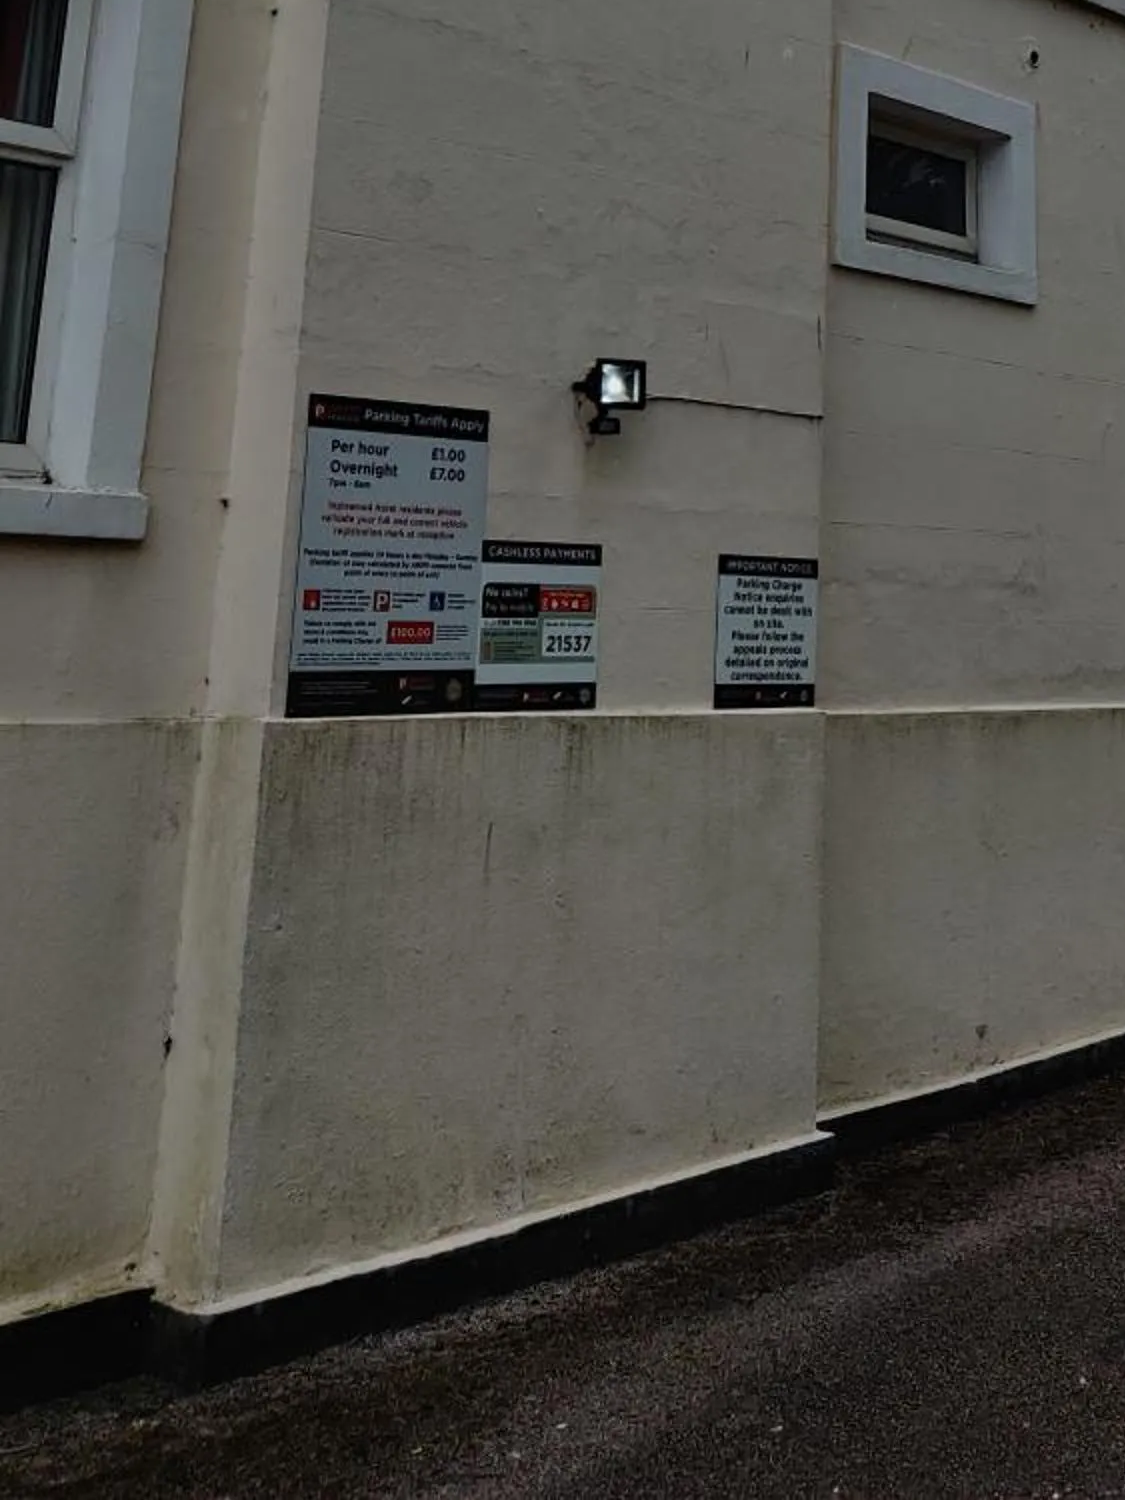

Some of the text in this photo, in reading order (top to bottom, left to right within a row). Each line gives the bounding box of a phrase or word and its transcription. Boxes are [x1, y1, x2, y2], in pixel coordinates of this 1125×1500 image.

[364, 408, 410, 427] Parking
[414, 413, 448, 429] Tariffs
[451, 417, 485, 433] Apply
[331, 439, 466, 462] Per hour £1.00
[329, 459, 466, 482] Overnight £7.00
[488, 545, 596, 561] CASHLESS PAYMENTS
[726, 558, 813, 574] IMPORTANT NOTICE
[737, 578, 803, 592] Parking Charge
[733, 591, 763, 602] Notice
[757, 605, 769, 615] be
[794, 606, 813, 617] with
[391, 627, 432, 638] £100.00
[731, 630, 804, 641] Please follow the
[545, 635, 592, 653] 21537
[733, 644, 802, 655] appeals process
[724, 656, 809, 669] detailed on original
